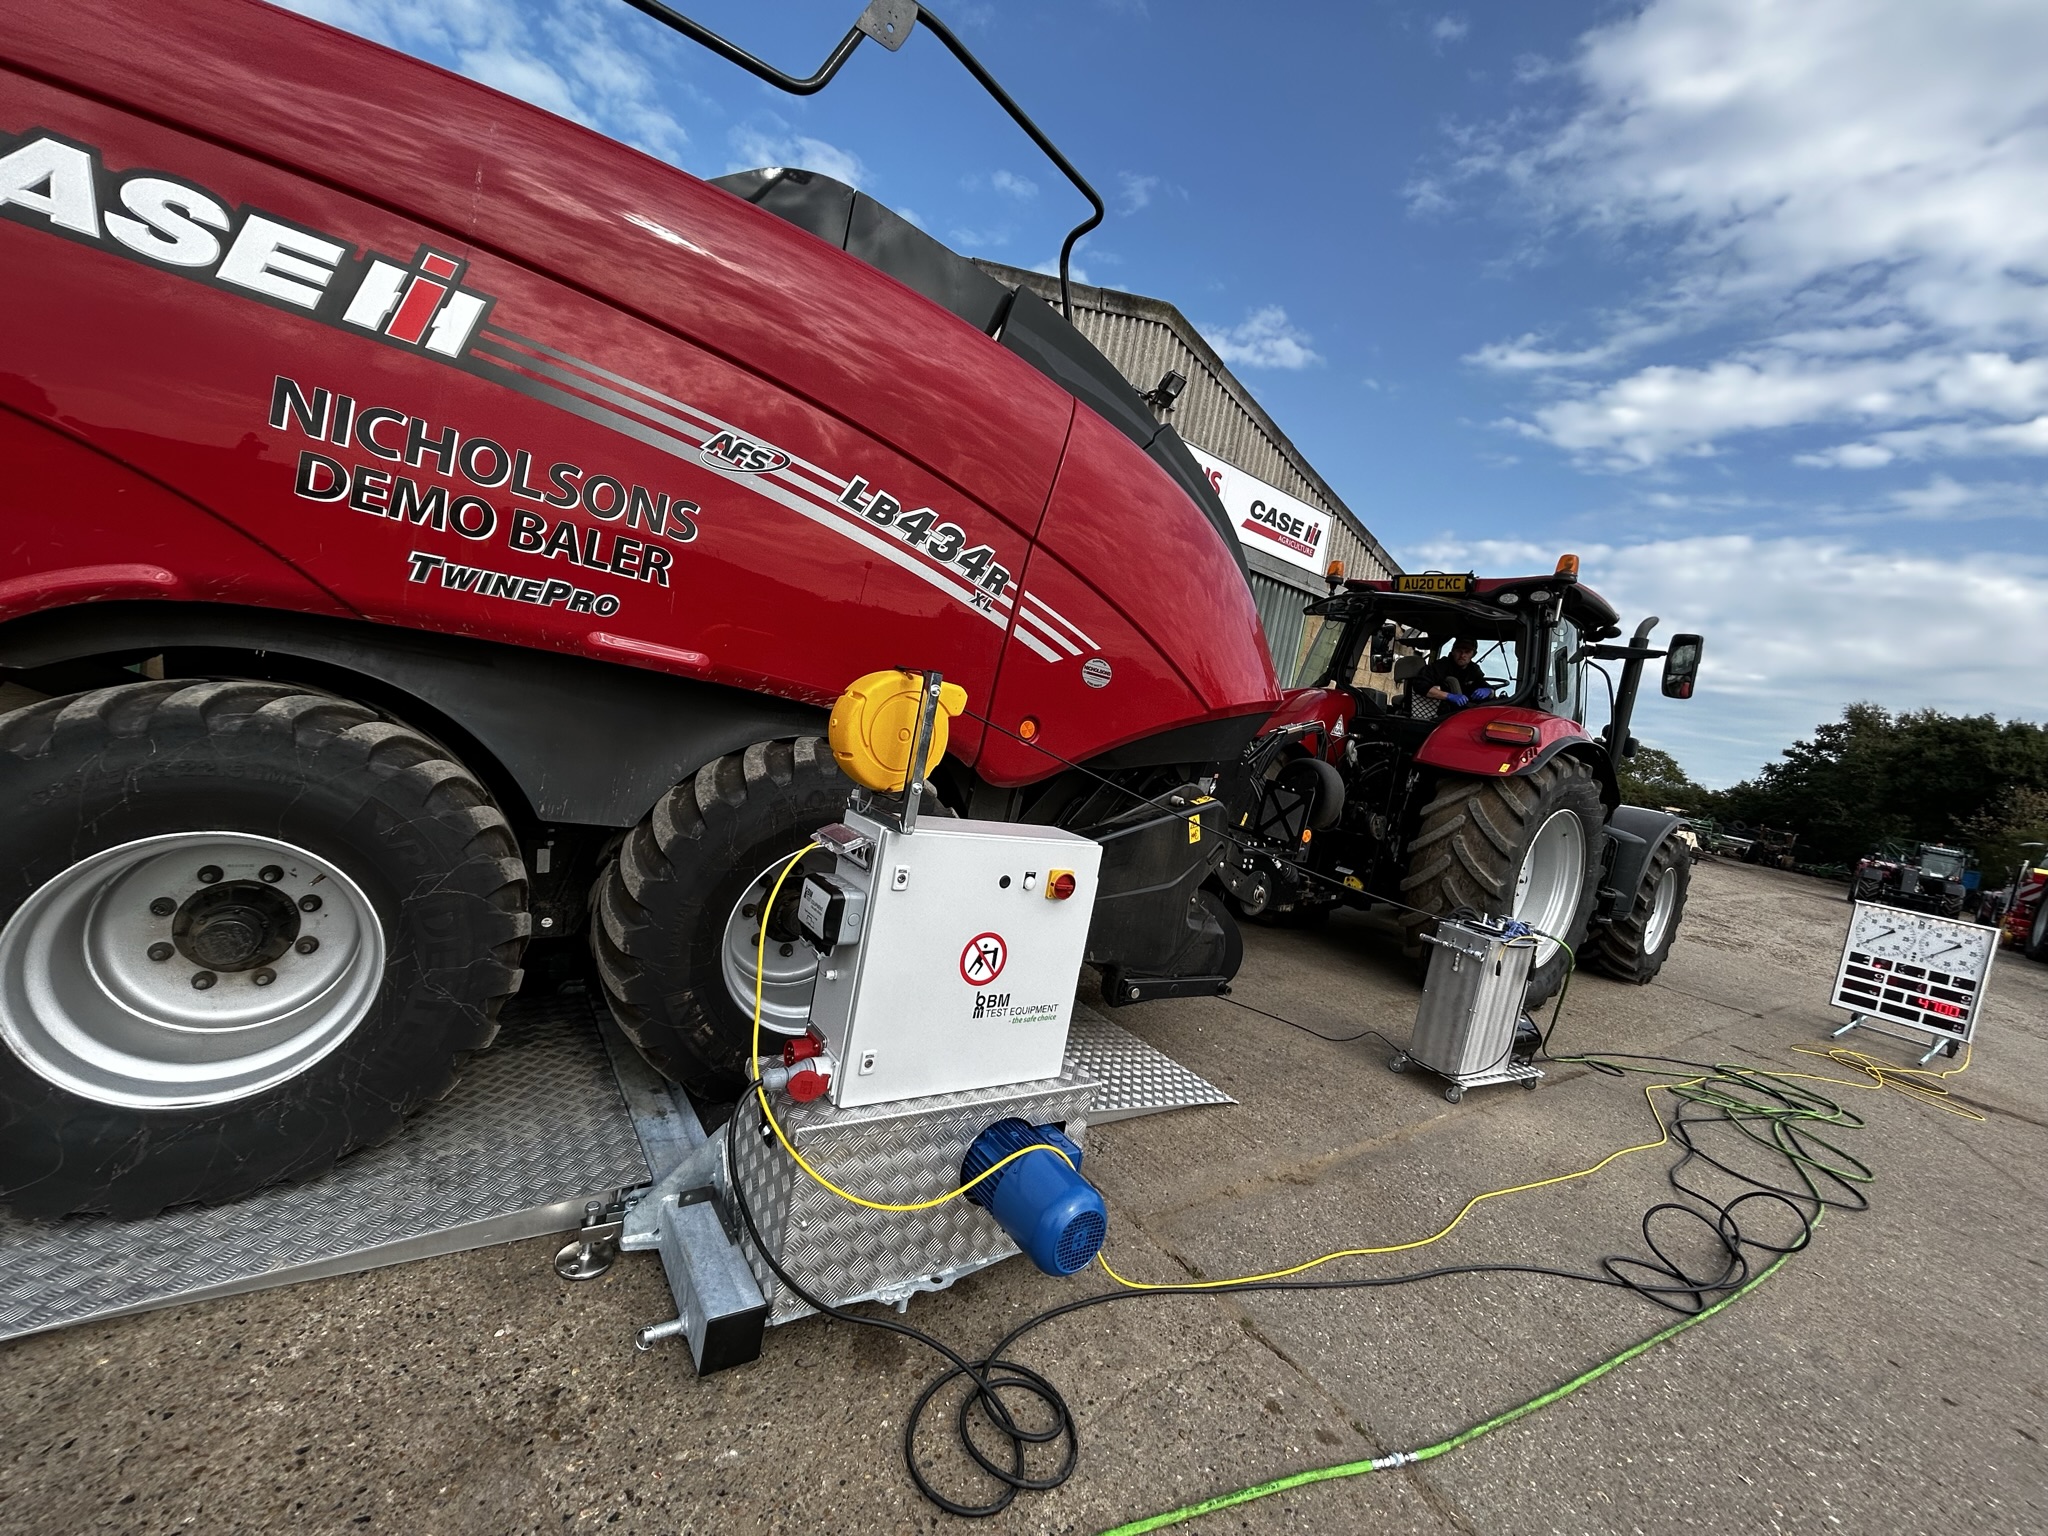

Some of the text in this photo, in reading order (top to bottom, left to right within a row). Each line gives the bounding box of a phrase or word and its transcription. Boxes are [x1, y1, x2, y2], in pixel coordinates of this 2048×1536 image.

[267, 375, 701, 543] NICHOLSONS
[700, 430, 776, 471] AFS
[294, 451, 673, 588] DEMO BALER
[1250, 500, 1305, 538] CASE
[837, 474, 1011, 597] LB434R
[1277, 535, 1314, 556] AGRICULTURE
[1404, 578, 1461, 590] AU20 CKC
[969, 590, 993, 613] XL
[986, 1003, 1059, 1018] TEST EQUIPMENT
[1011, 1016, 1023, 1024] the
[1023, 1015, 1037, 1023] safe
